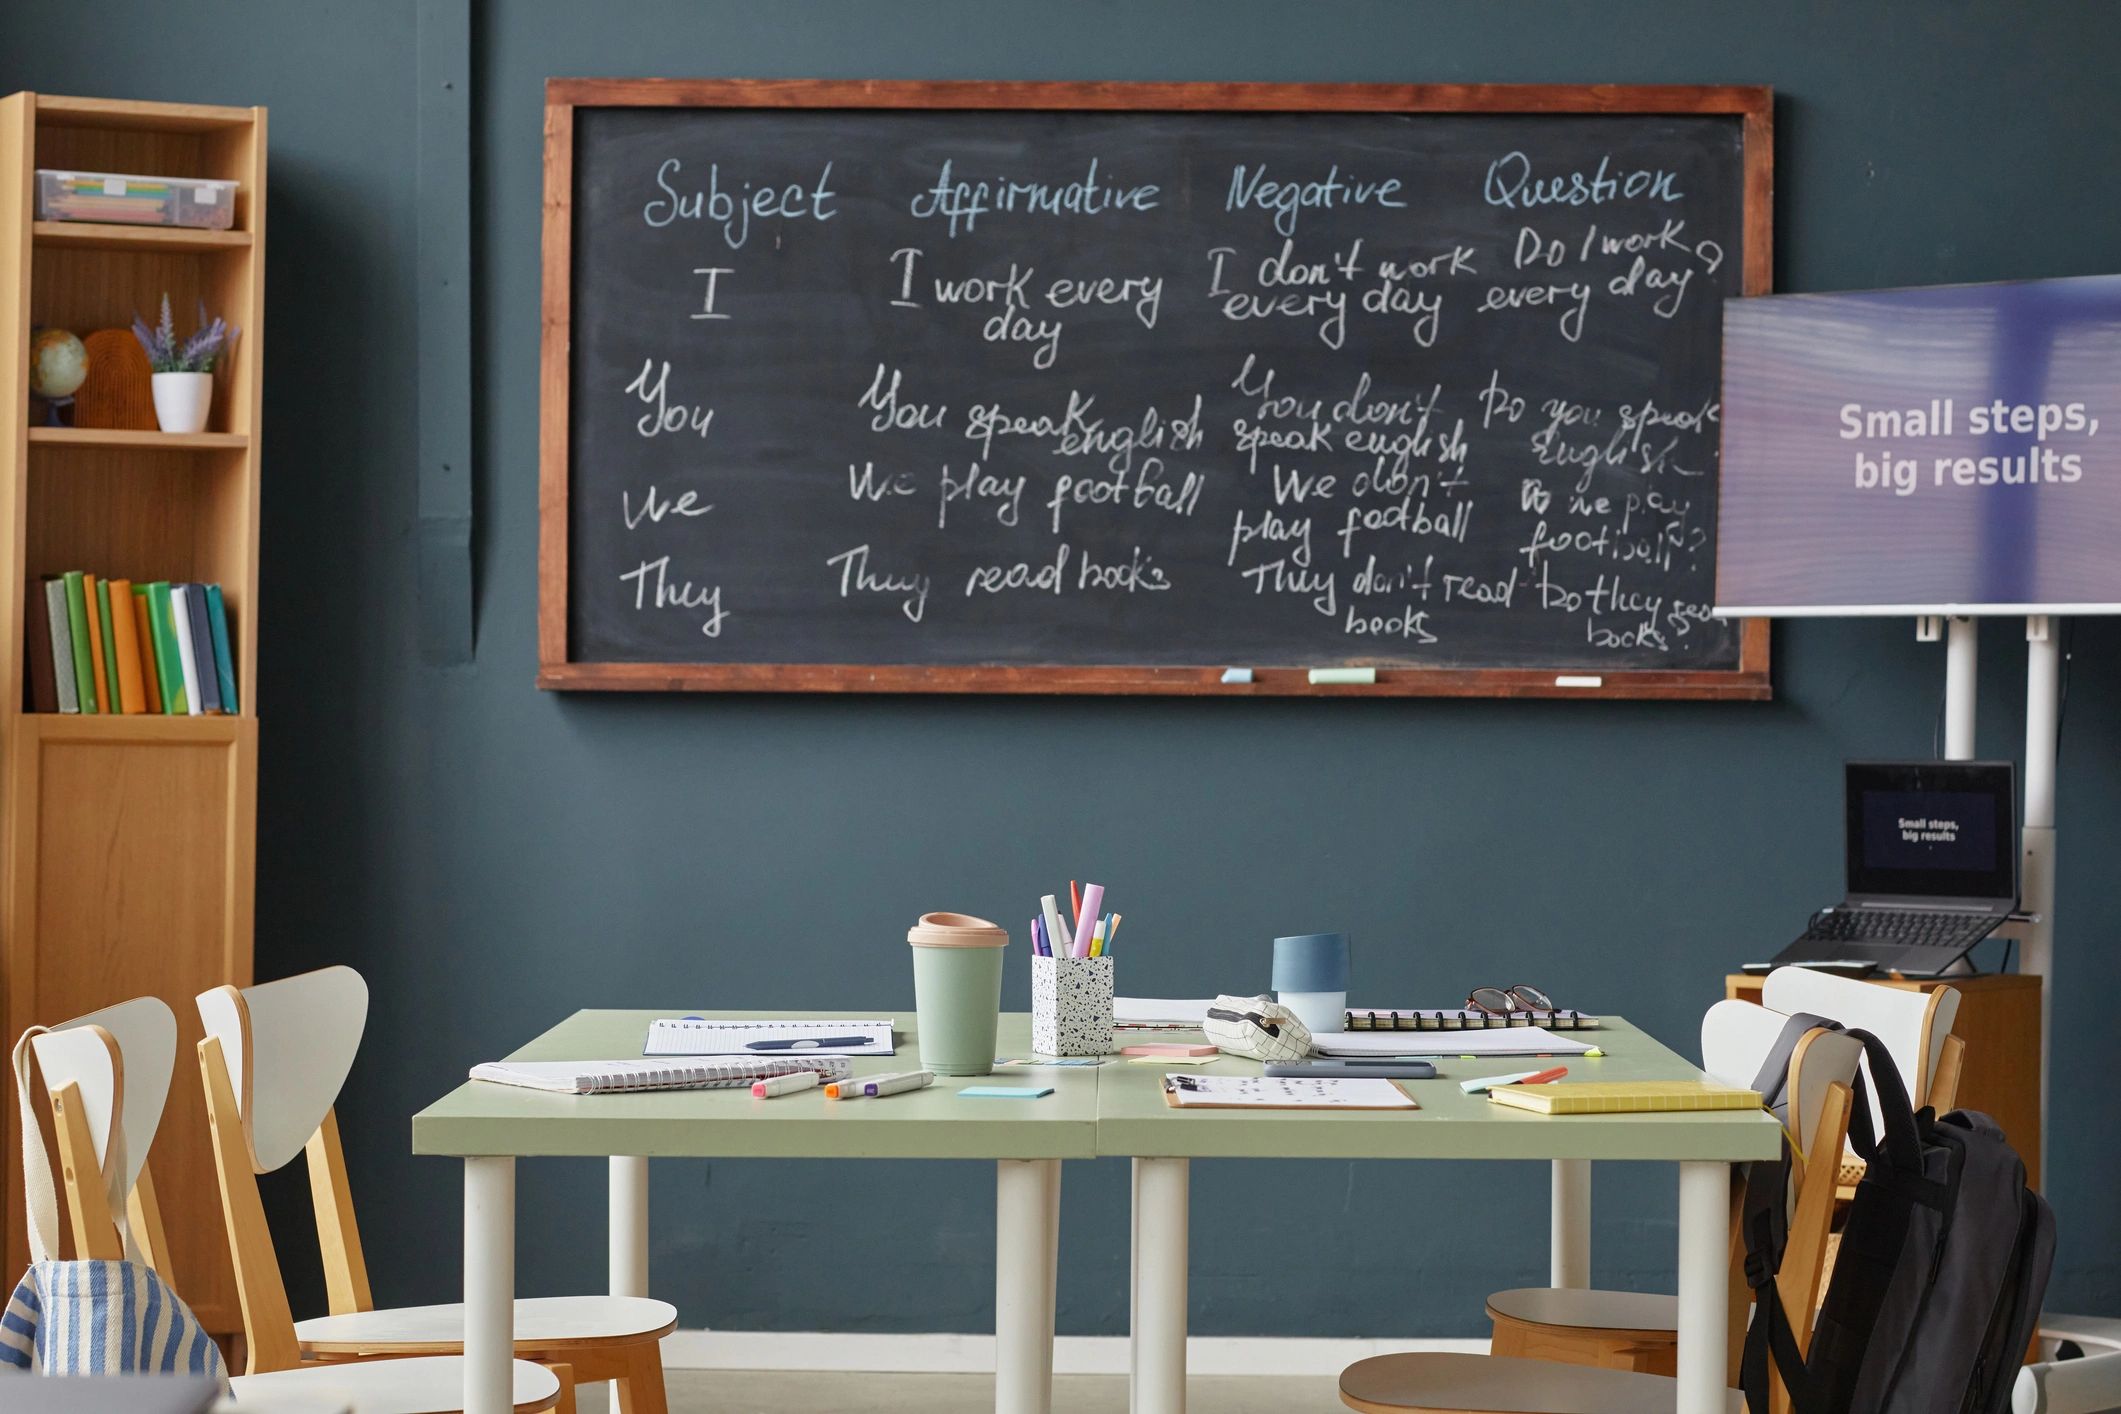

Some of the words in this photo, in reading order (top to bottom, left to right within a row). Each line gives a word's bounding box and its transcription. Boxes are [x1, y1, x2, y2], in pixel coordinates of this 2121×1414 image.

[644, 158, 838, 249] Subject
[911, 158, 1160, 238] Affirmative
[1226, 164, 1407, 236] Negative
[1484, 151, 1684, 209] Question
[1207, 247, 1237, 298] I
[1259, 239, 1365, 287] don't
[1379, 246, 1477, 281] work
[1514, 226, 1565, 269] Do
[1602, 219, 1692, 255] work
[690, 268, 735, 319] I
[890, 248, 923, 308] I
[935, 263, 1034, 309] work
[1045, 277, 1163, 329] every
[1222, 291, 1346, 349] every
[1362, 280, 1442, 347] day
[1477, 282, 1590, 342] every
[983, 303, 1062, 369] day
[625, 358, 713, 437] You
[858, 363, 947, 432] You
[1840, 399, 1953, 439] Small
[1969, 400, 2099, 441] steps,
[1234, 419, 1333, 475] speak
[1855, 451, 1917, 496] big
[1934, 446, 2082, 486] results
[623, 486, 715, 530] We
[850, 462, 916, 502] We
[939, 462, 1026, 529] play
[1047, 457, 1204, 533] football
[1274, 464, 1336, 505] We
[1228, 510, 1311, 567] play
[1337, 496, 1473, 558] football
[619, 555, 731, 638] They
[966, 544, 1070, 597] read
[1443, 567, 1517, 608] read
[1345, 604, 1438, 643] books
[1898, 818, 1926, 829] Small
[1928, 819, 1959, 831] steps,
[1902, 830, 1919, 843] big
[1920, 830, 1956, 842] results
